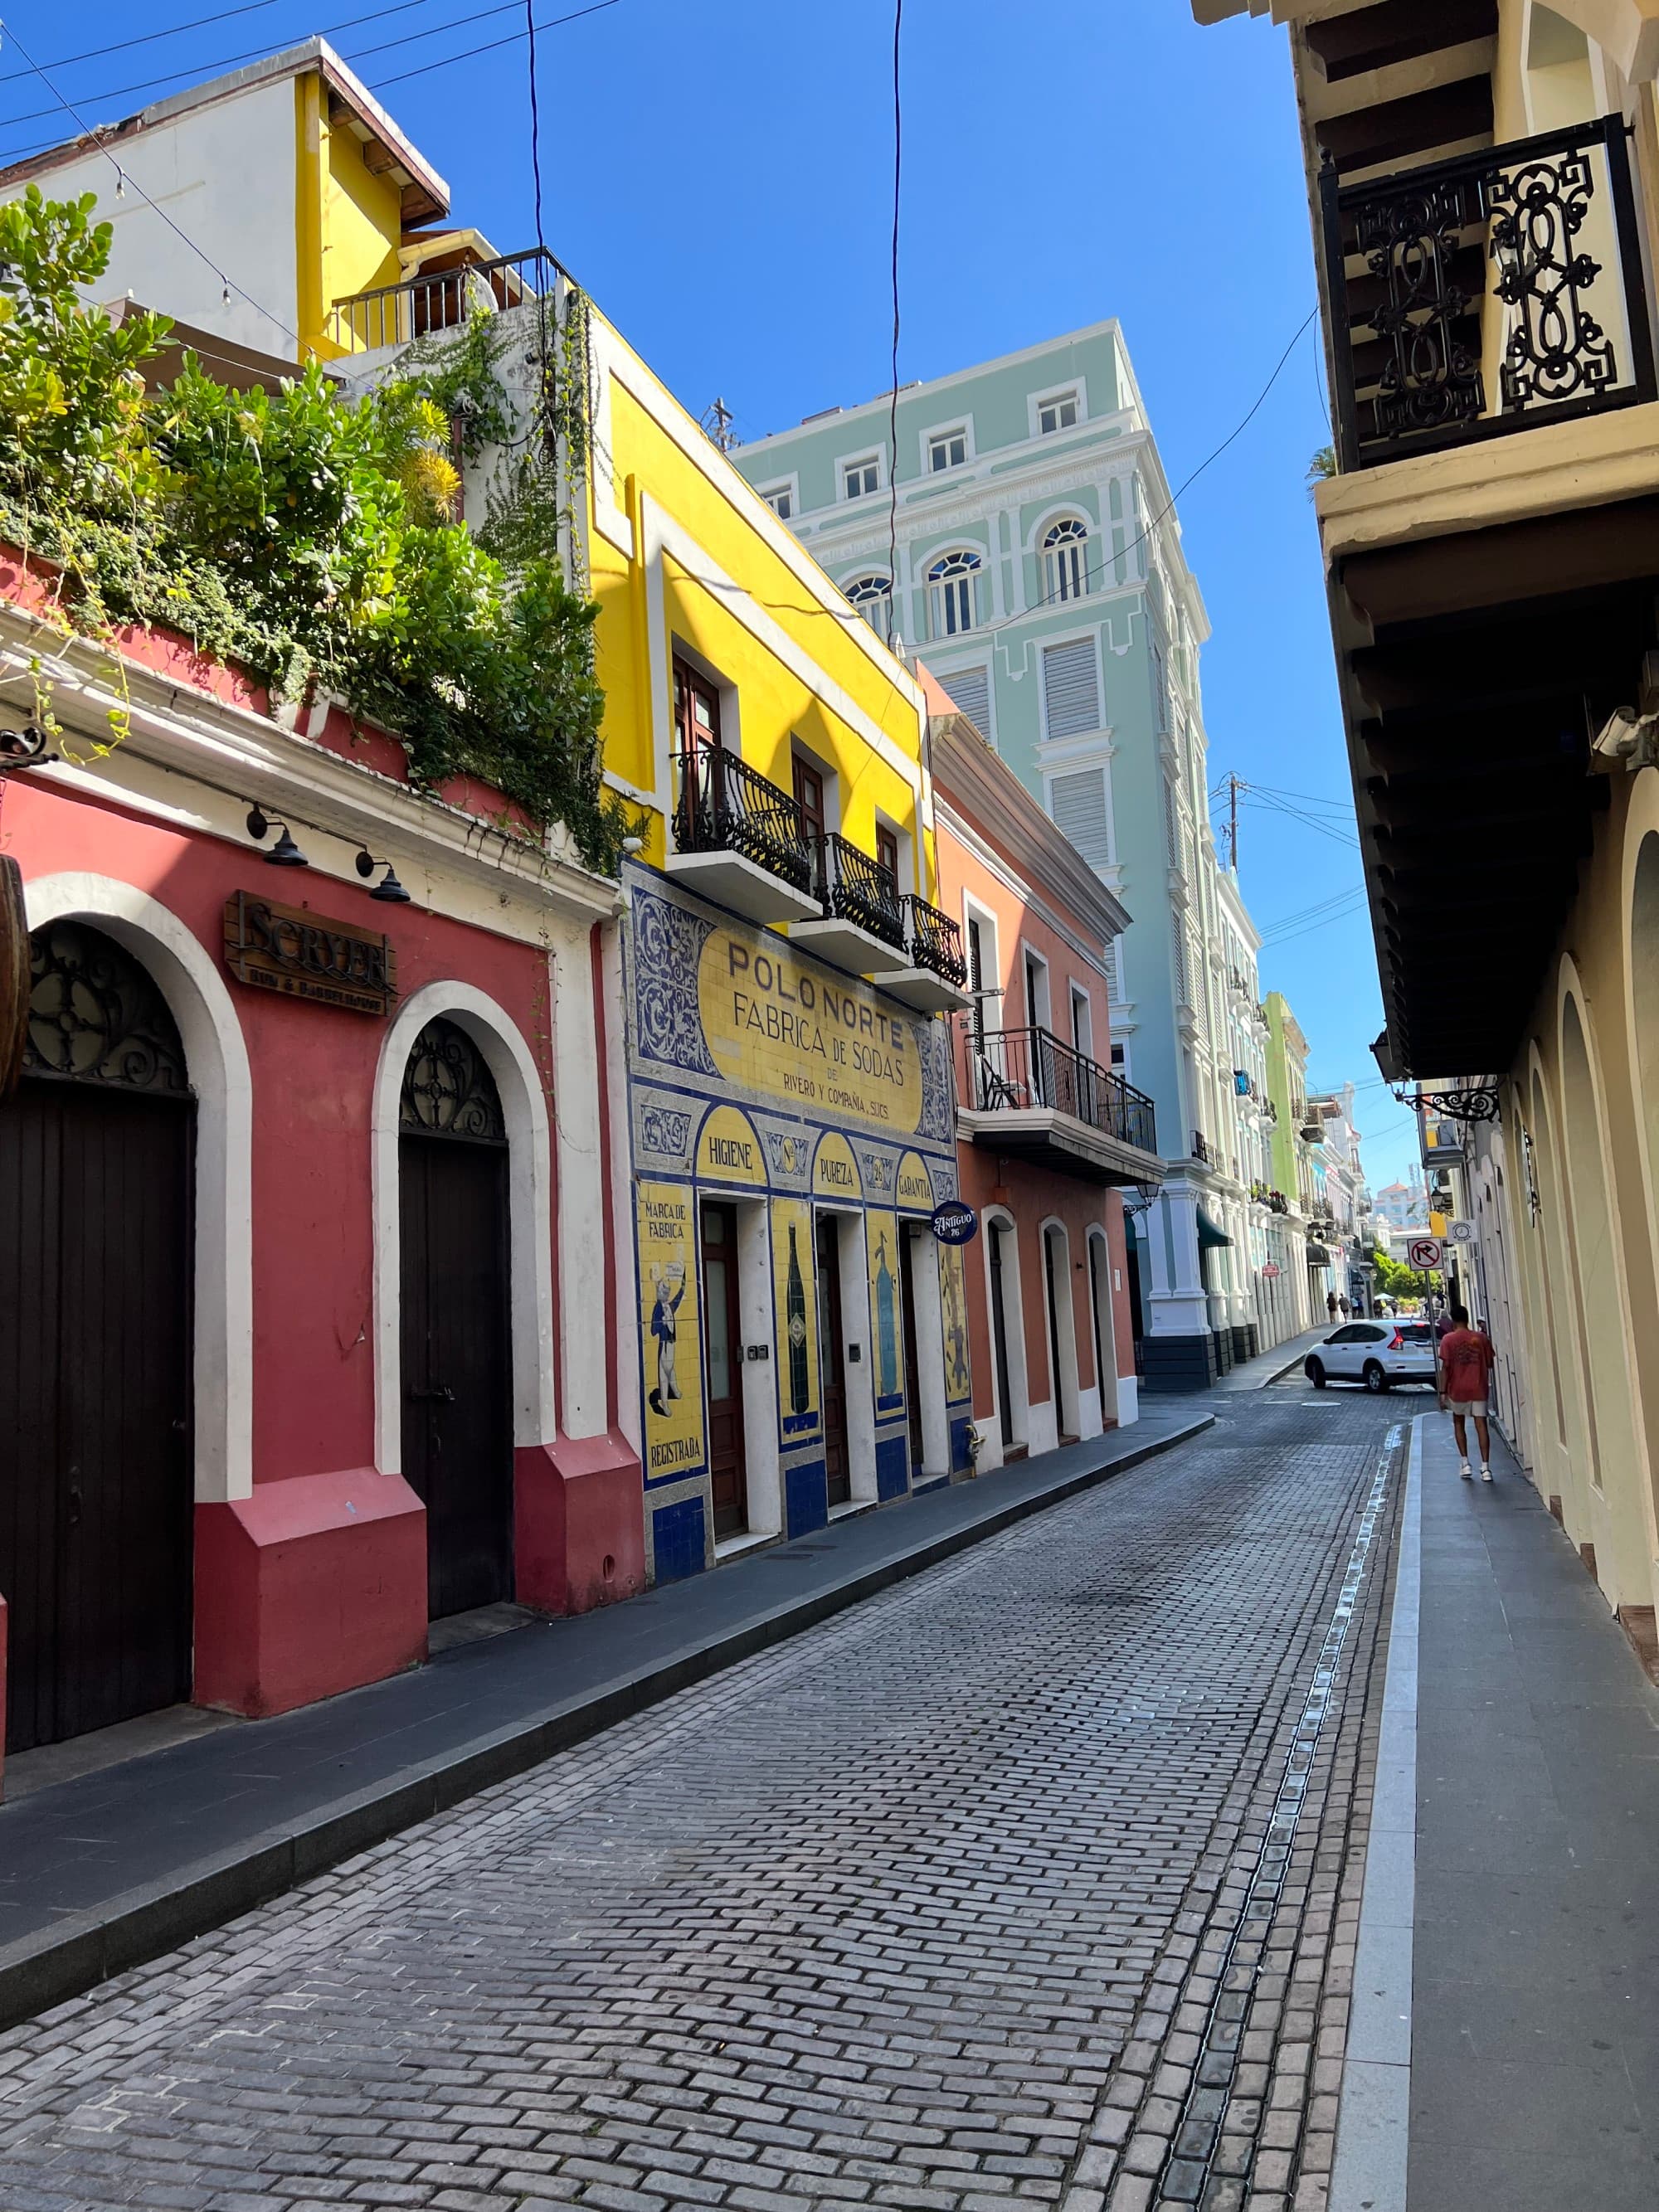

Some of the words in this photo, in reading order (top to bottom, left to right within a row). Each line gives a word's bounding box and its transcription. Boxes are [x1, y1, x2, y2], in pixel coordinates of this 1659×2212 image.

[247, 902, 389, 985] SCRYER
[285, 979, 294, 991] &
[728, 941, 815, 1009] POLO
[823, 986, 903, 1051] NORTE
[733, 991, 826, 1058] FABRICA
[833, 1038, 847, 1065] DE
[853, 1041, 903, 1087] SODAS
[784, 1073, 815, 1097] RIVERO
[818, 1085, 825, 1101] Y
[827, 1067, 838, 1082] DE
[708, 1136, 752, 1169] HIGIENE
[820, 1159, 854, 1186] PUREZA
[874, 1164, 883, 1182] 26
[898, 1174, 932, 1200] GARANTIA
[645, 1202, 674, 1219] MARCA
[676, 1204, 686, 1220] DE
[649, 1222, 684, 1238] FABRICA
[933, 1213, 972, 1237] ANTIGUO
[650, 1437, 701, 1468] REGISTRADA
